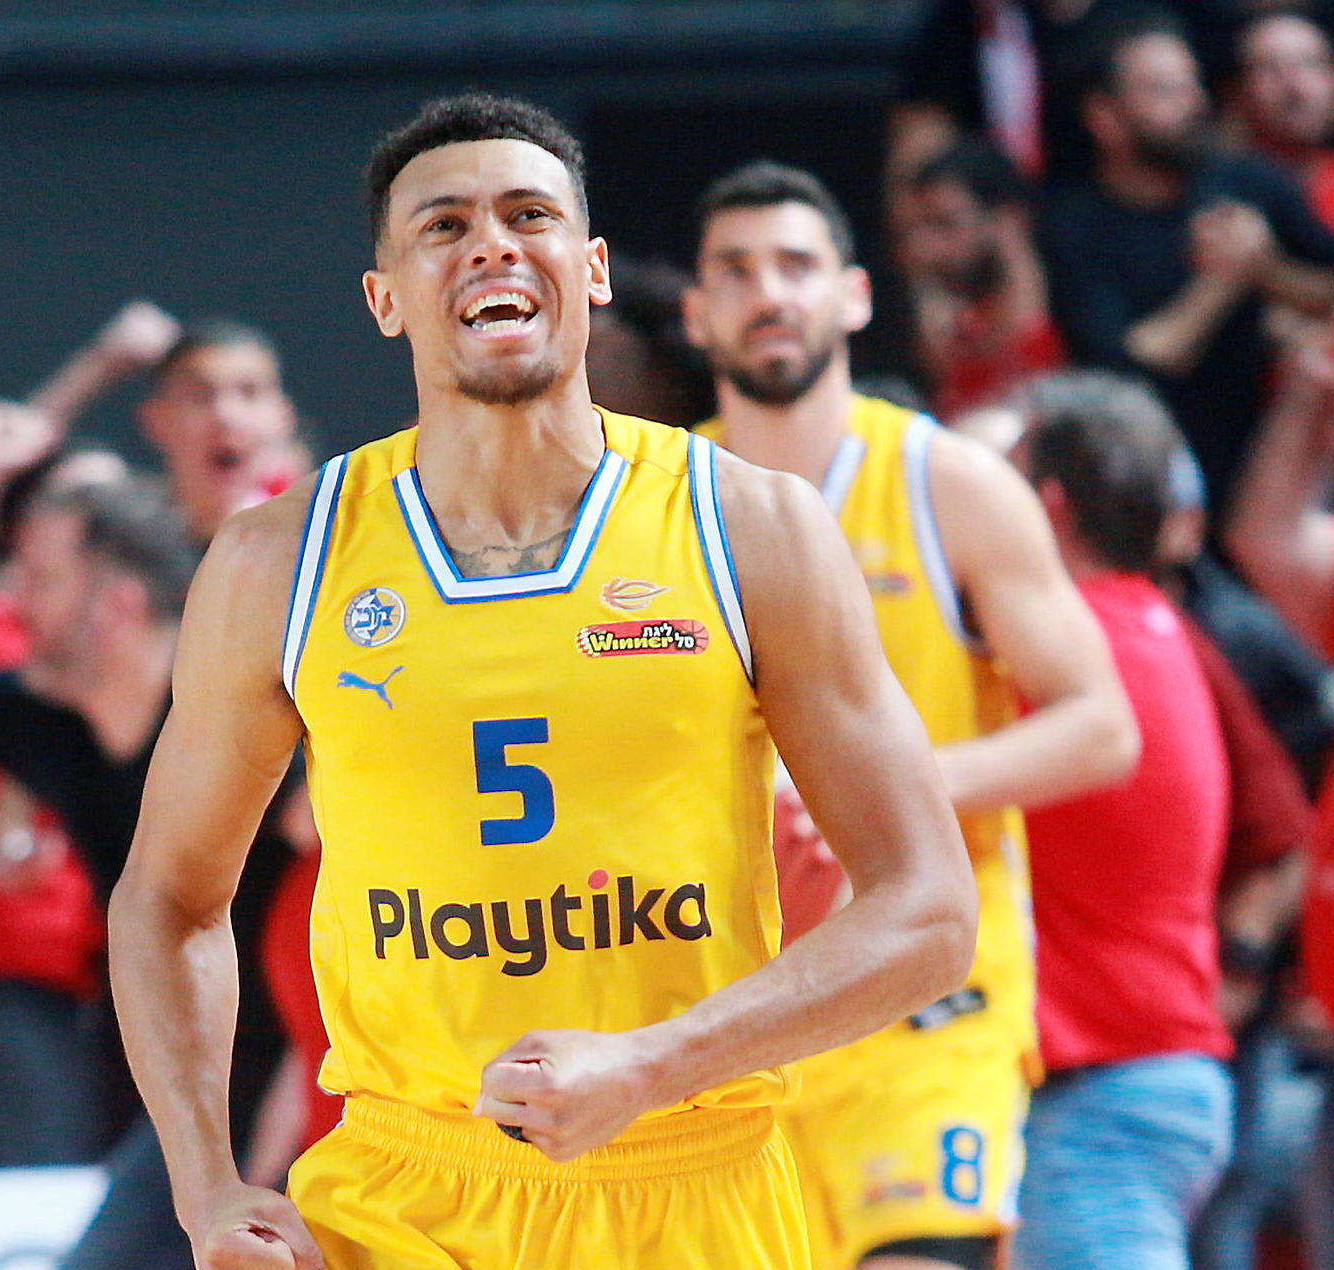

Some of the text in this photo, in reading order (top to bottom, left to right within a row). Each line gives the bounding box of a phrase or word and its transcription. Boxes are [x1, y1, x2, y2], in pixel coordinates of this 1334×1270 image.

[589, 633, 674, 652] Winner
[643, 622, 673, 638] ליגת
[674, 631, 695, 649] סל
[473, 717, 556, 846] 5
[368, 869, 712, 977] Playtika
[940, 1126, 983, 1205] 8
